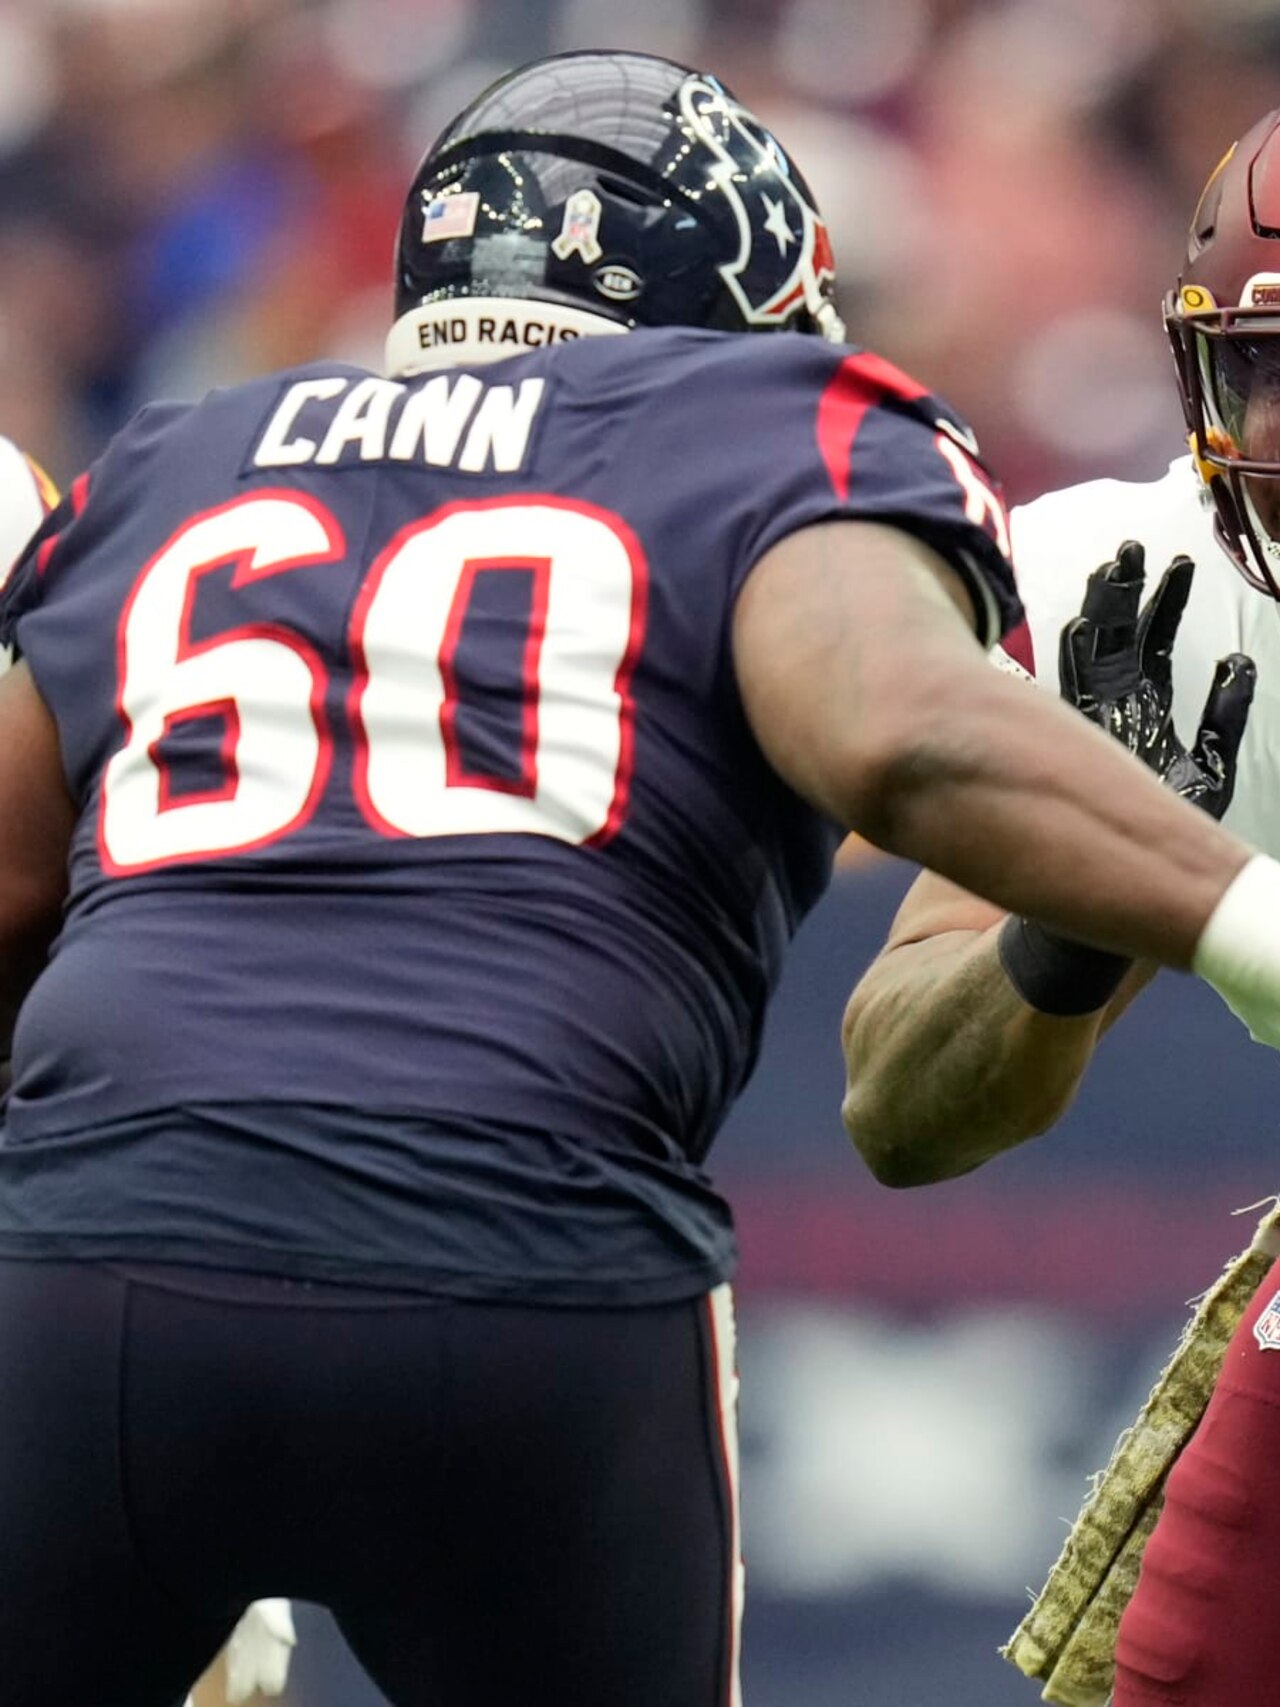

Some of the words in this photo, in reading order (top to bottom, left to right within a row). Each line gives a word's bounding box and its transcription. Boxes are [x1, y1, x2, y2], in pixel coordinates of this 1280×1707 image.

[418, 318, 468, 350] END
[253, 374, 546, 473] CANN
[96, 486, 650, 878] 60
